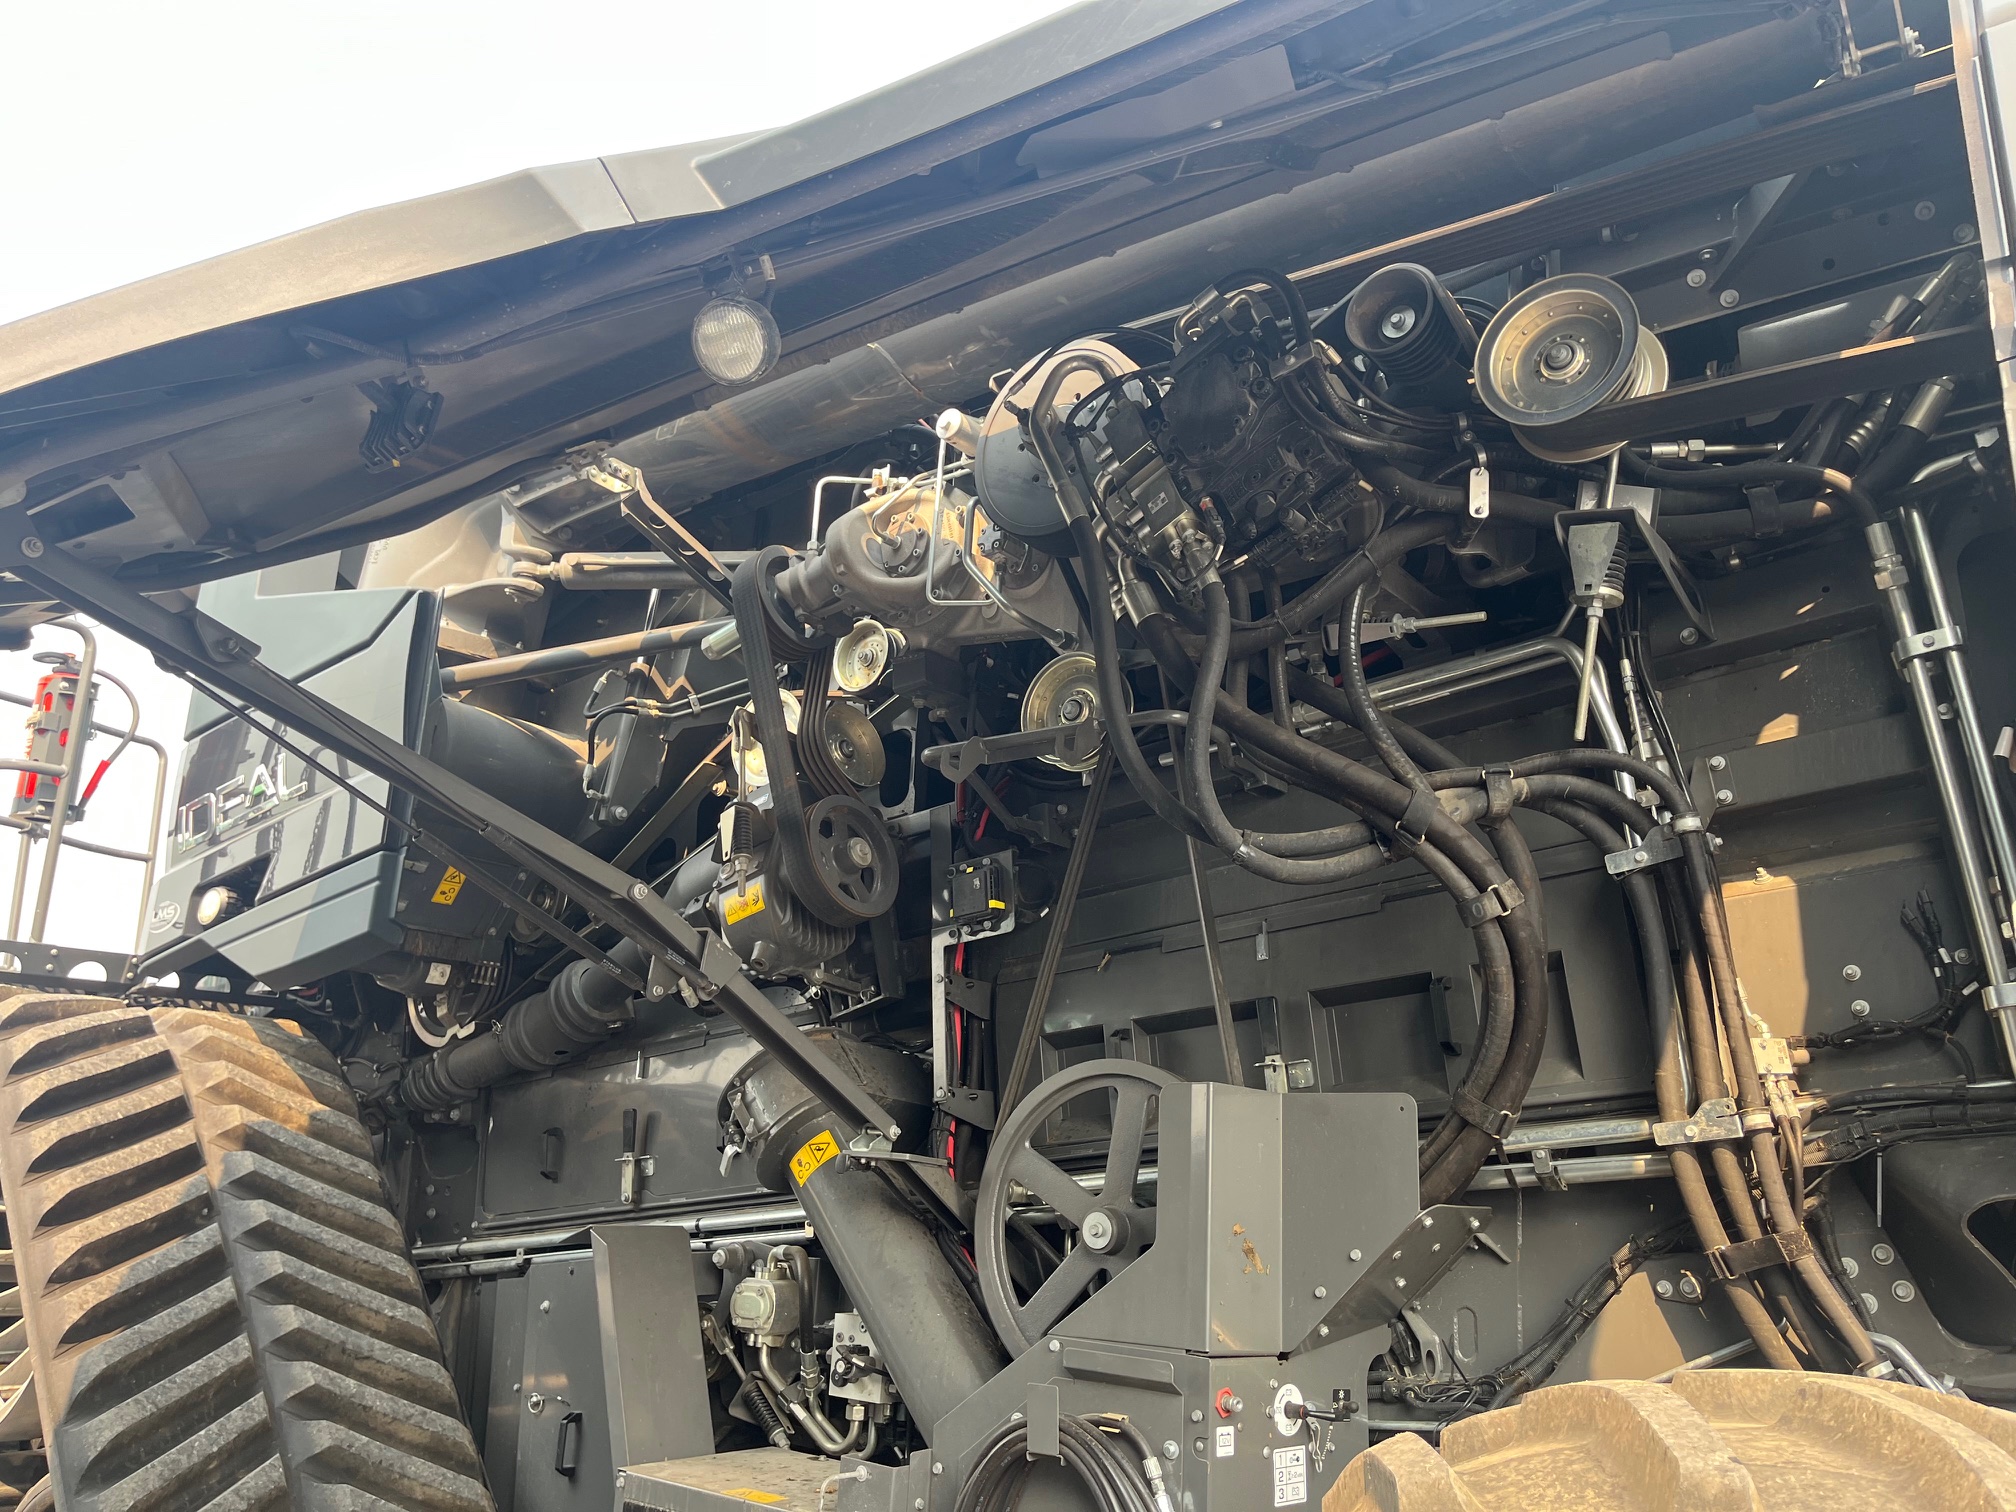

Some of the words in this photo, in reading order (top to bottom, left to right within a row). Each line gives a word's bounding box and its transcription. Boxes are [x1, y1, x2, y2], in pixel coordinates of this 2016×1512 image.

[178, 753, 308, 853] IDEAL
[1278, 1471, 1284, 1482] 2
[1278, 1488, 1284, 1499] 3
